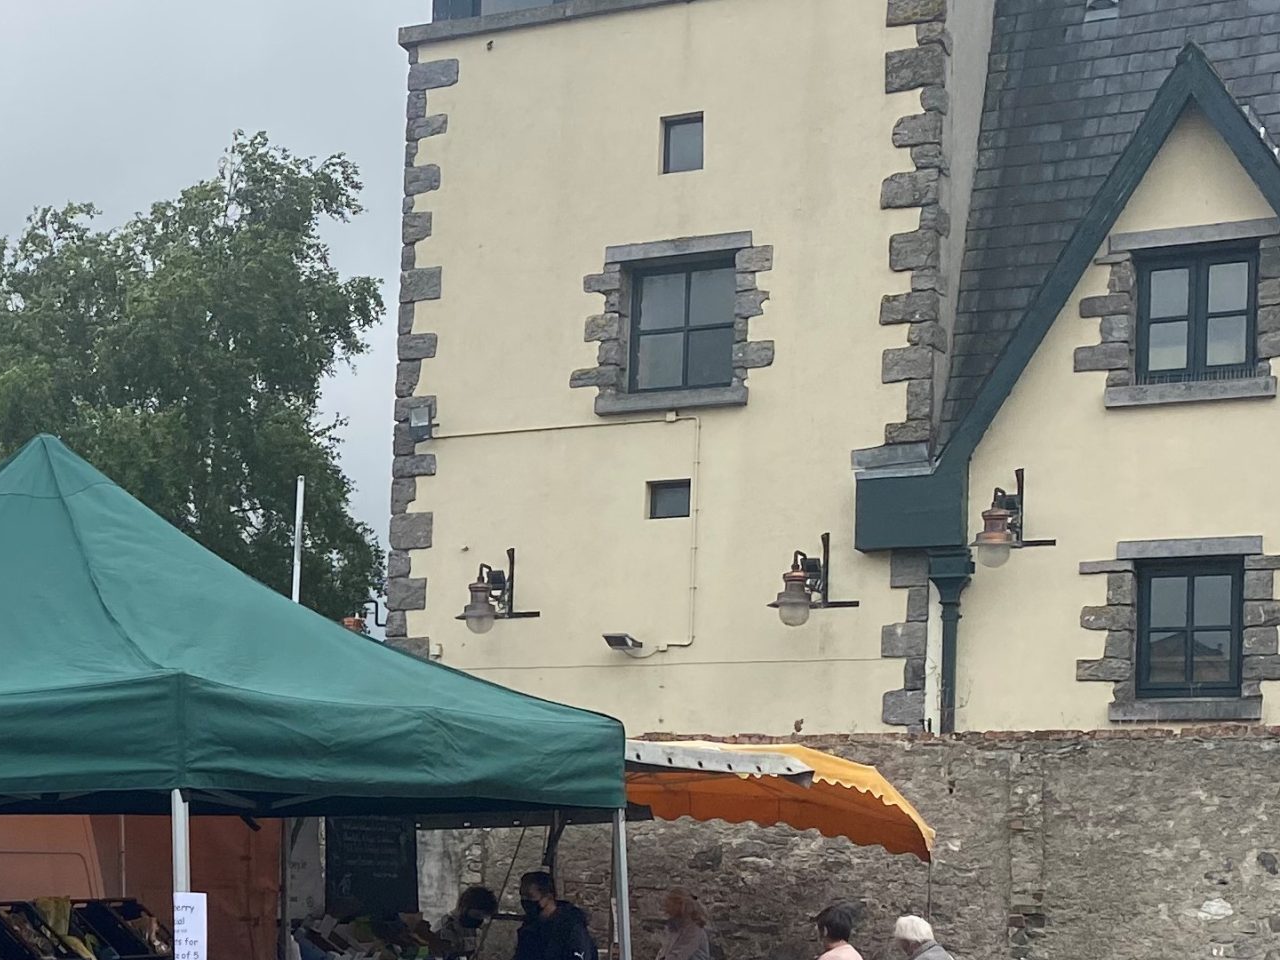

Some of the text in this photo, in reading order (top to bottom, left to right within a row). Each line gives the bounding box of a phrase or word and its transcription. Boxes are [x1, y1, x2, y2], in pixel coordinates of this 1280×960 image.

[174, 904, 195, 913] erry
[185, 937, 198, 946] for
[181, 951, 191, 960] of
[193, 951, 199, 960] 5
